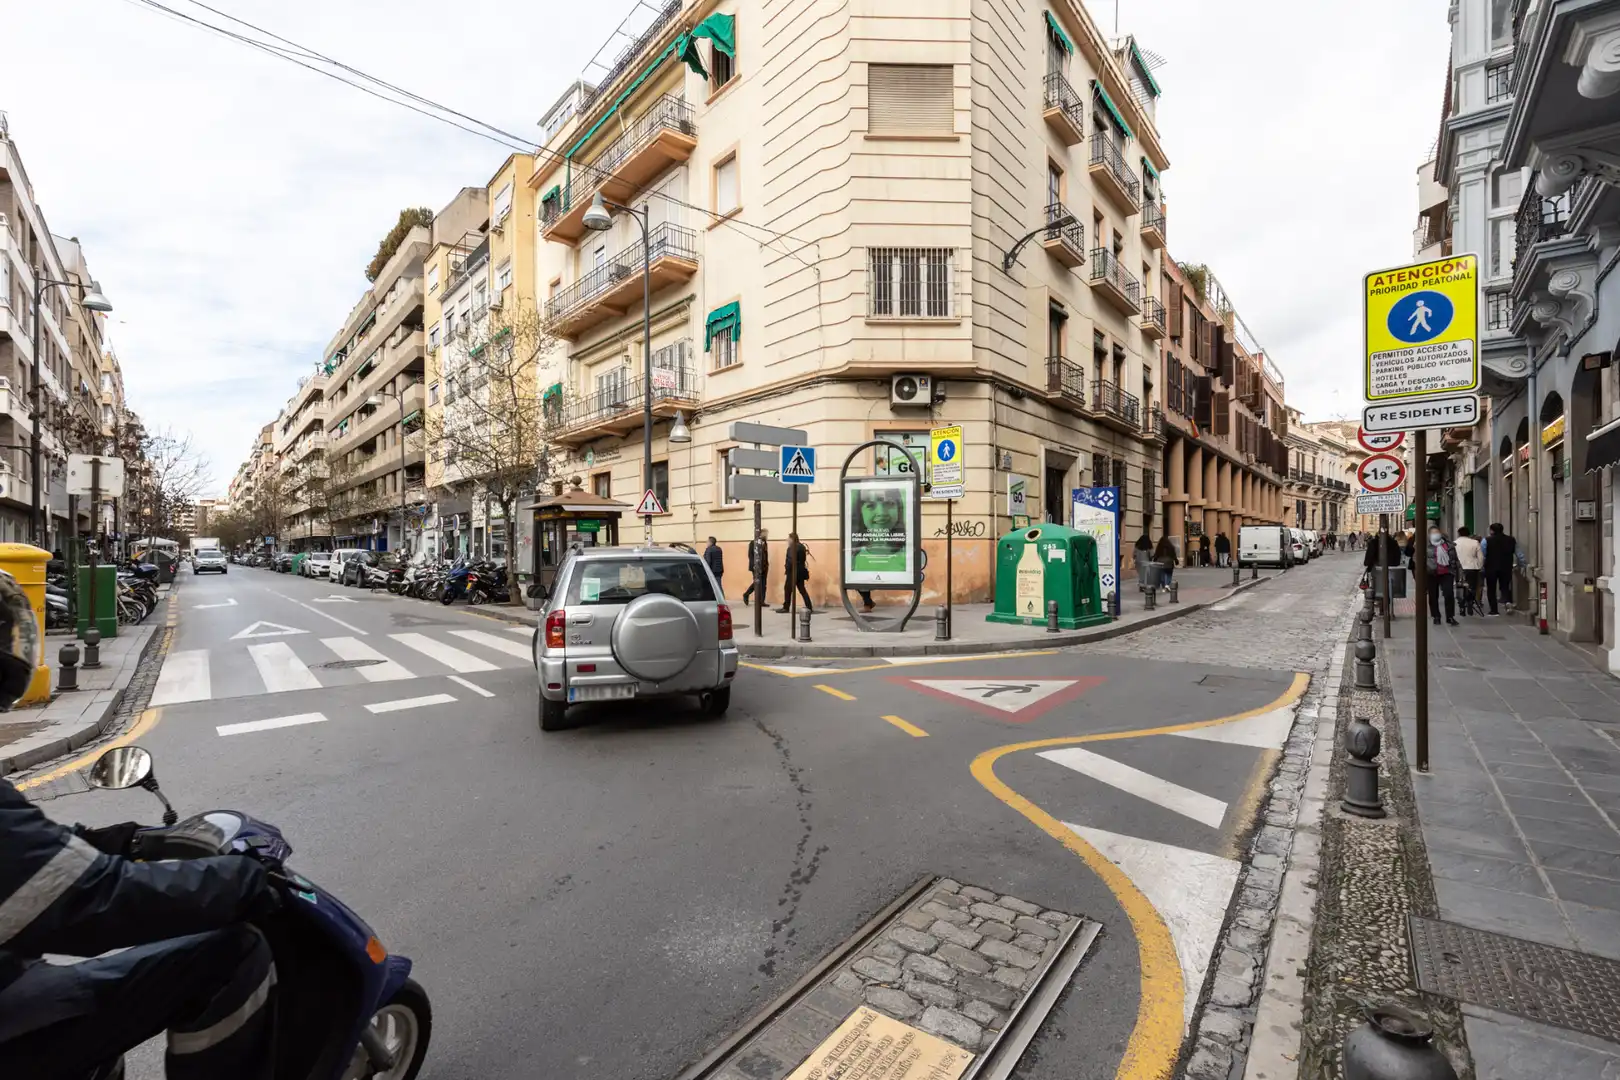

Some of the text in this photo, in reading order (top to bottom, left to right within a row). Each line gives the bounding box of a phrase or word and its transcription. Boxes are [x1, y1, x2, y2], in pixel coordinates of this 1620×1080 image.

[1373, 260, 1468, 287] ATENCIÓN
[1370, 272, 1472, 296] PRIORIDAD PEATONAL
[1373, 349, 1414, 360] PERMITIDO
[1416, 344, 1448, 354] ACCESO
[1417, 350, 1468, 361] AUTORIZADOS
[1375, 364, 1404, 374] PARKING
[1439, 357, 1472, 366] VICTORIA
[1375, 372, 1408, 381] HOTELES
[1375, 381, 1398, 389] CARGA
[1368, 404, 1473, 422] Y RESIDENTES
